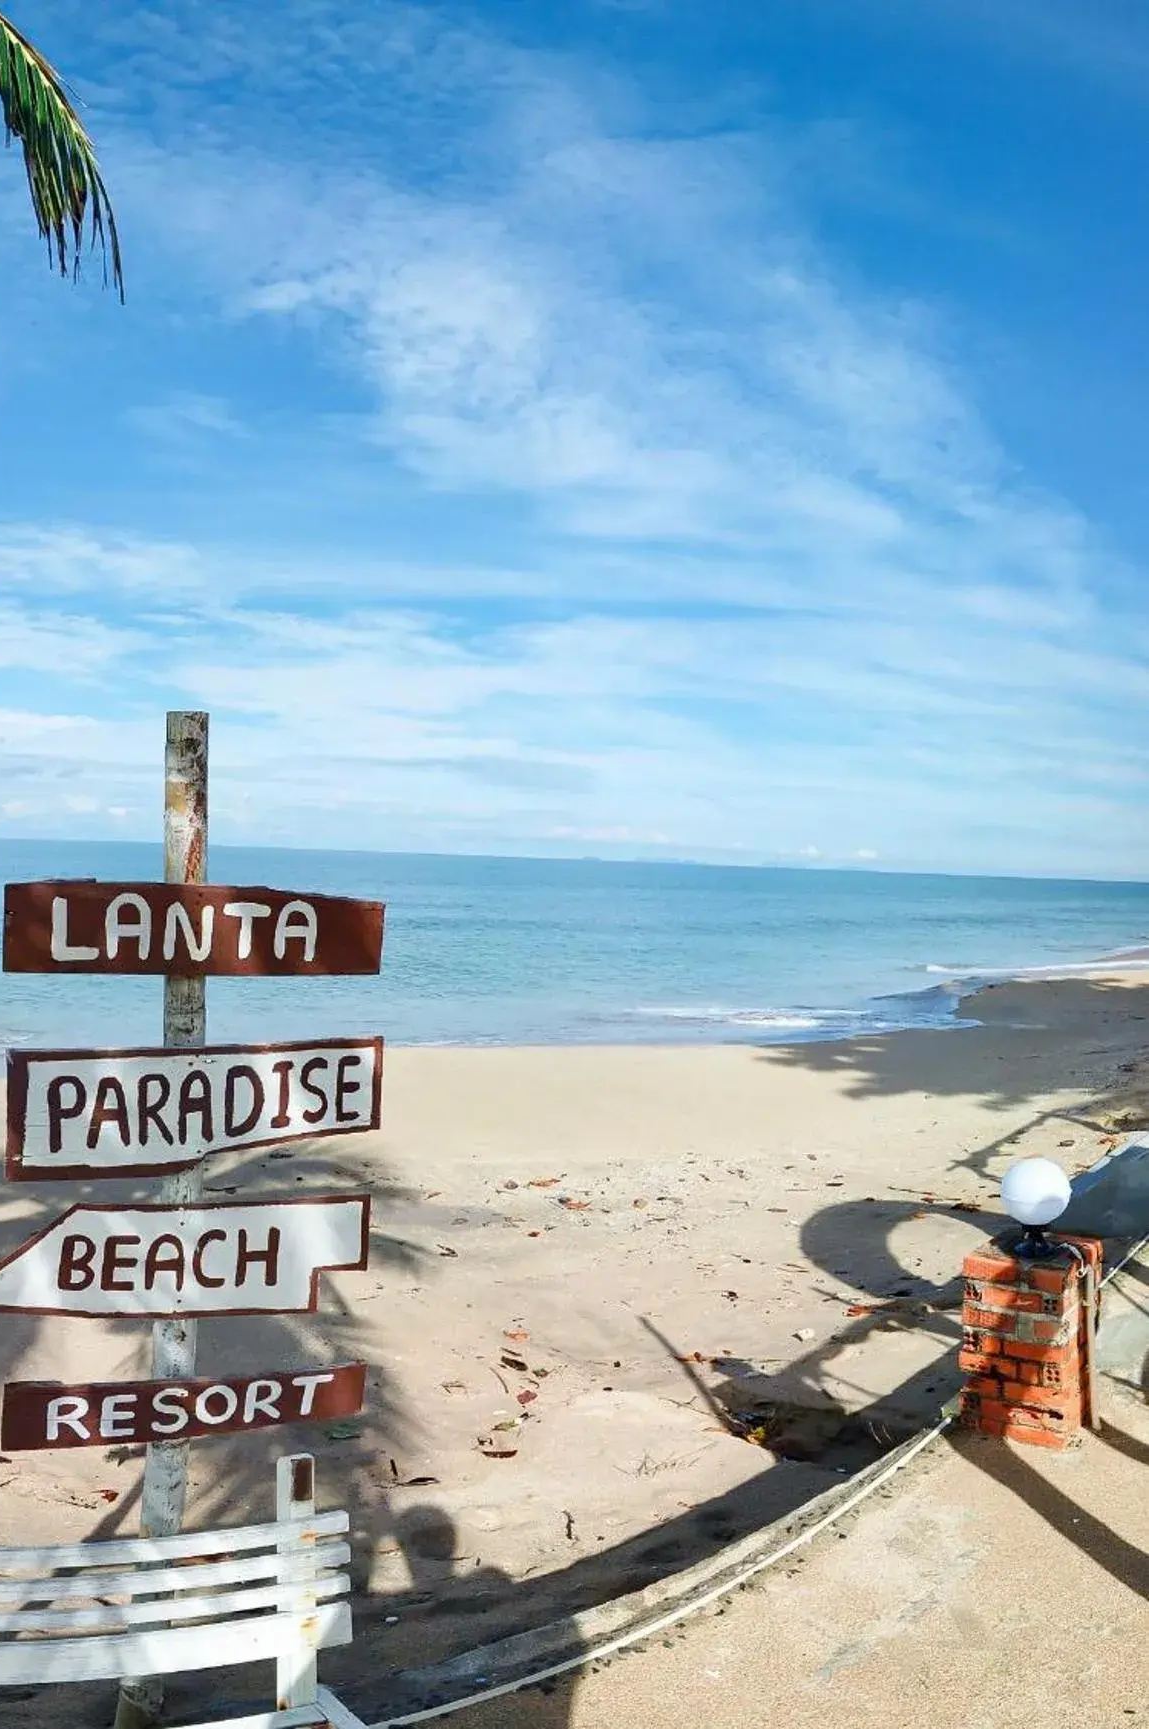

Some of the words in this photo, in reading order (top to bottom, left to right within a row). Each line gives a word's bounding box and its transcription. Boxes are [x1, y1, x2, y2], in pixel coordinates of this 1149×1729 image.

[50, 892, 318, 963] LANTA
[47, 1055, 362, 1154] PARADISE
[57, 1226, 281, 1292] BEACH
[45, 1373, 335, 1441] RESORT
